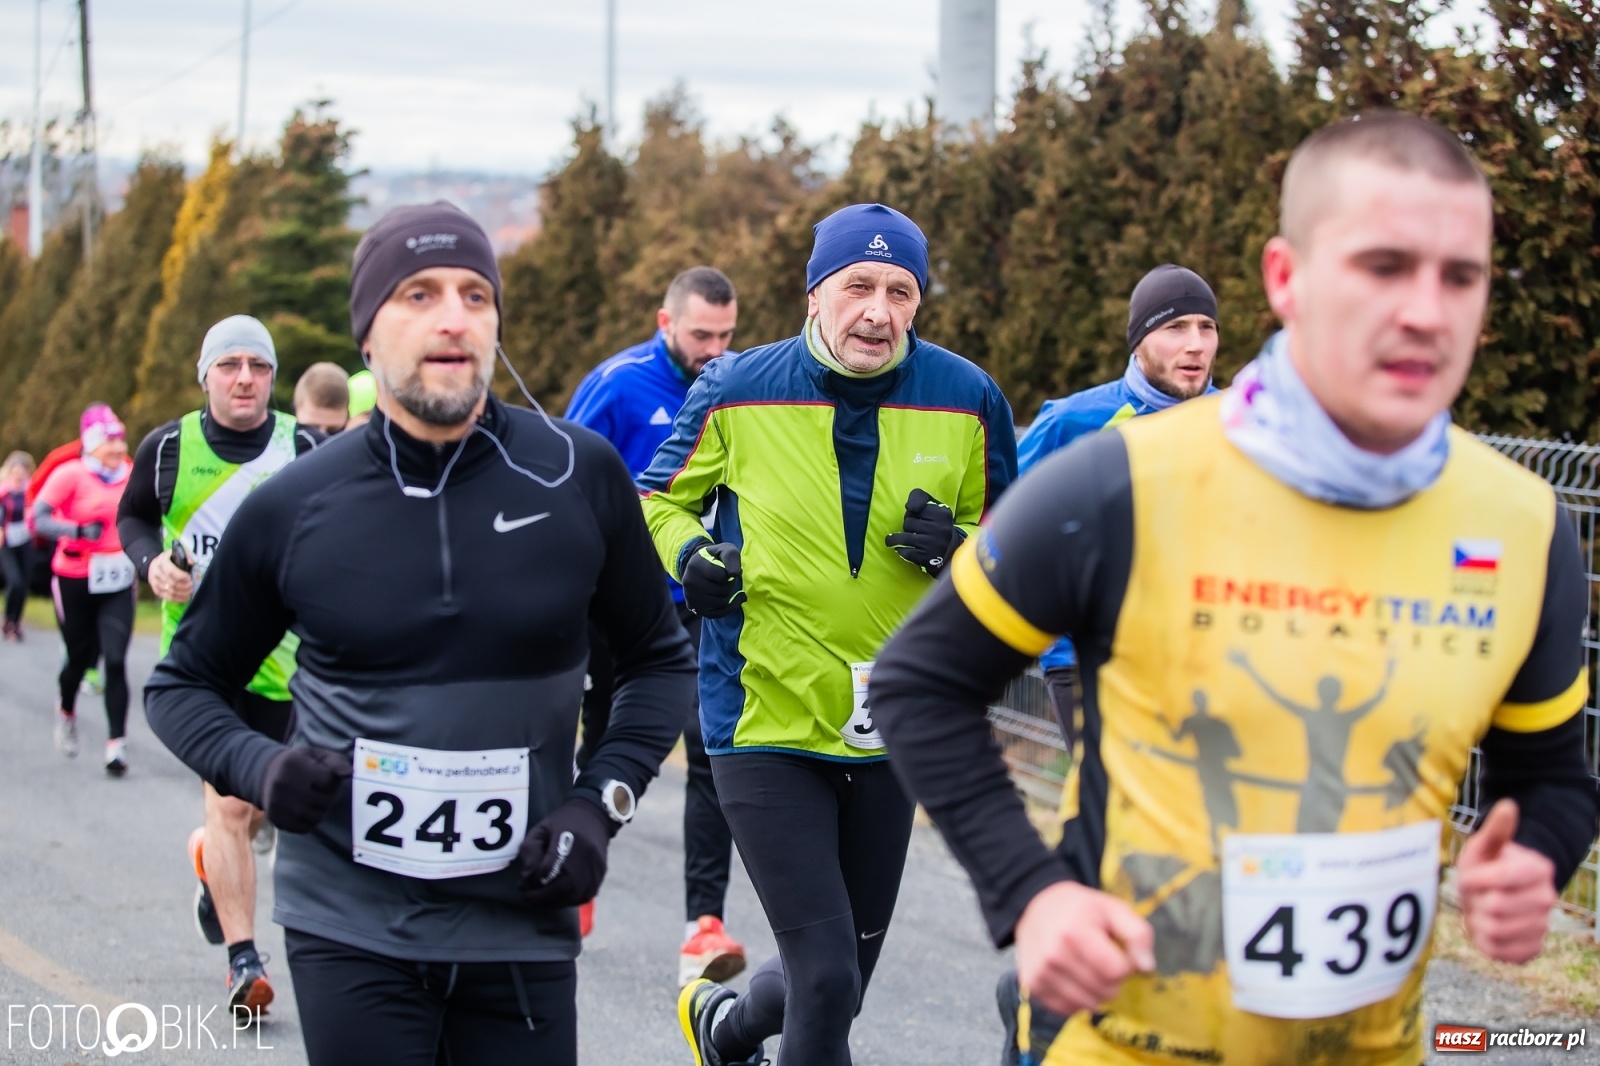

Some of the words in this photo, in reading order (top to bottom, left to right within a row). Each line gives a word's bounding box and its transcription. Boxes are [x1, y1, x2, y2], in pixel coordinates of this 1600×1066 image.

[865, 250, 893, 258] odlo
[1193, 574, 1370, 617] ENERGY
[364, 791, 513, 853] 243
[1243, 891, 1422, 977] 439
